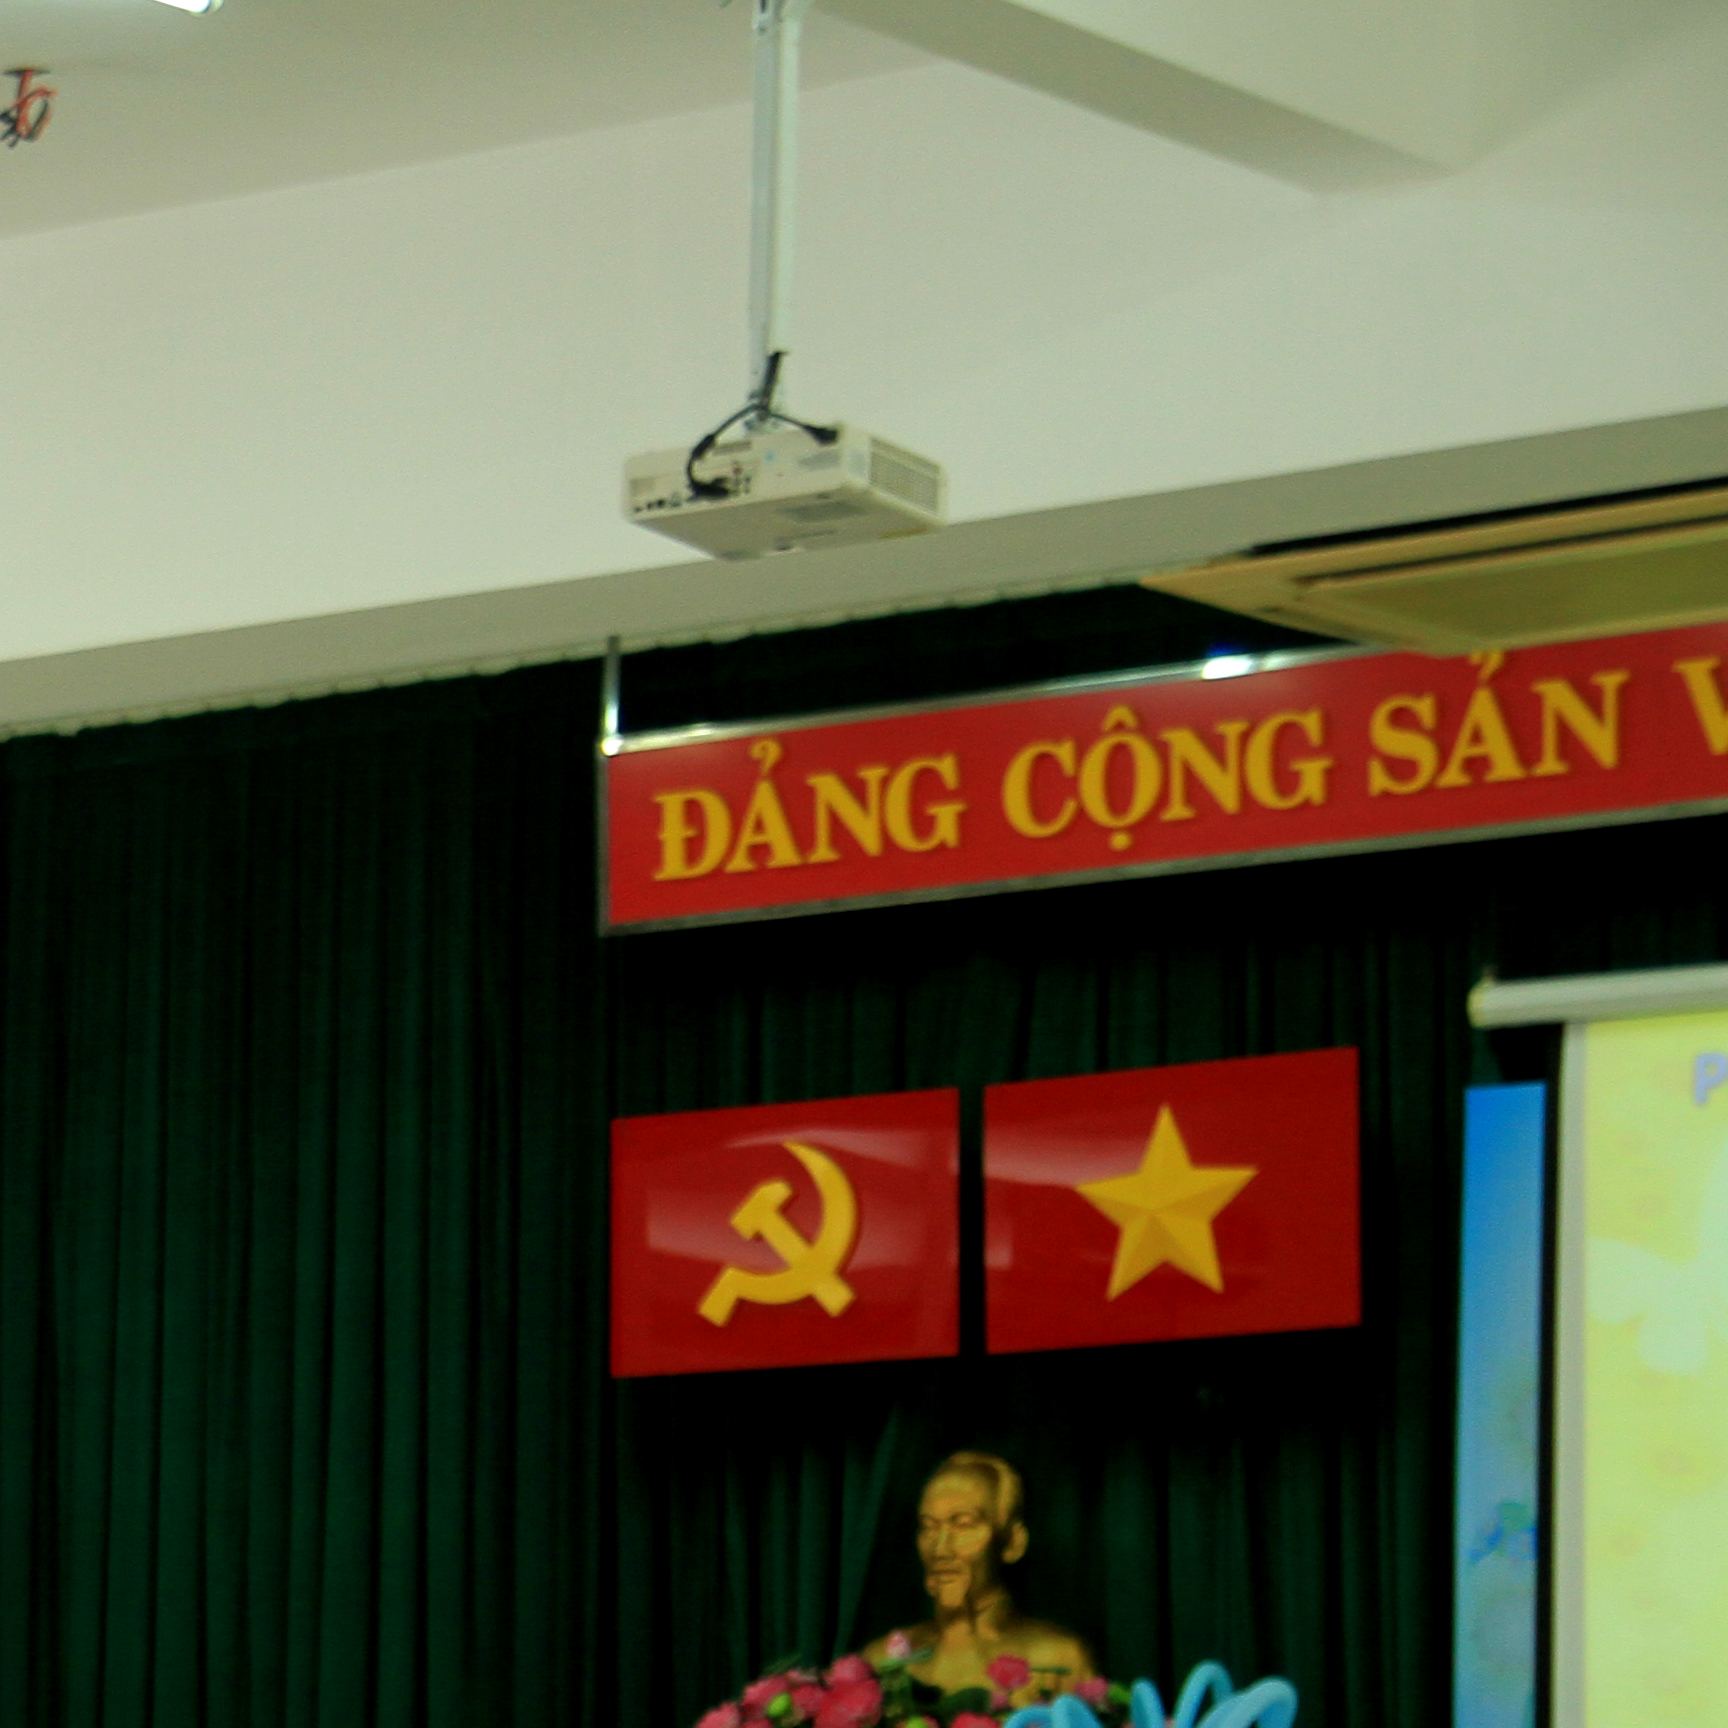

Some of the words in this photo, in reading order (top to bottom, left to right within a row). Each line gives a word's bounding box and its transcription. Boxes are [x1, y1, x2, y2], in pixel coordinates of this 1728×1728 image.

[653, 738, 966, 882] ĐẢNG
[1002, 705, 1332, 851] CỘNG
[1367, 650, 1628, 799] SẢN
